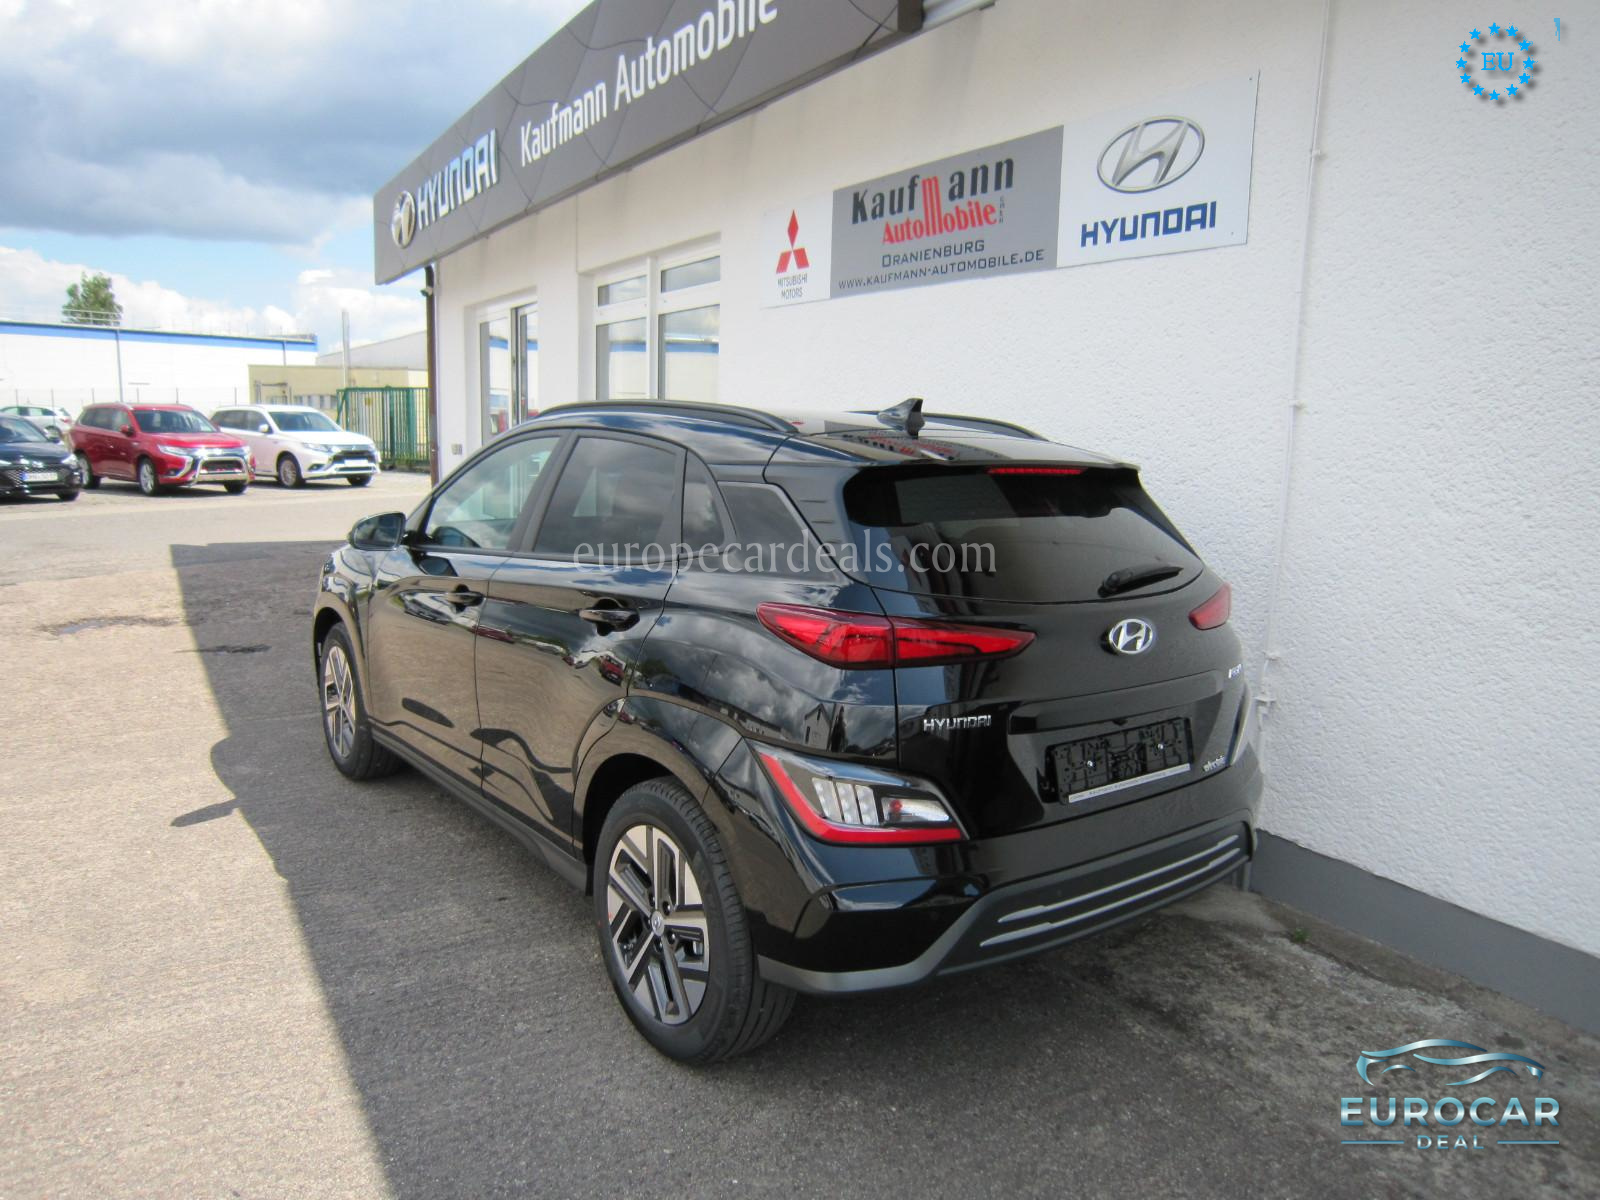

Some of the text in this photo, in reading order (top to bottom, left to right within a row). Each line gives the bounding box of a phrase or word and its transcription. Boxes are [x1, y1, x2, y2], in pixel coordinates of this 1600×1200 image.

[520, 81, 608, 167] Kaufmann
[417, 128, 498, 231] HYUNDAI
[851, 157, 1014, 225] Kaufmann
[1080, 201, 1217, 248] HYUNDAI
[881, 239, 985, 268] ORANIENBURG
[777, 273, 808, 288] MITSUBISHI
[781, 287, 803, 300] MOTORS
[923, 714, 992, 732] HYUNDAI
